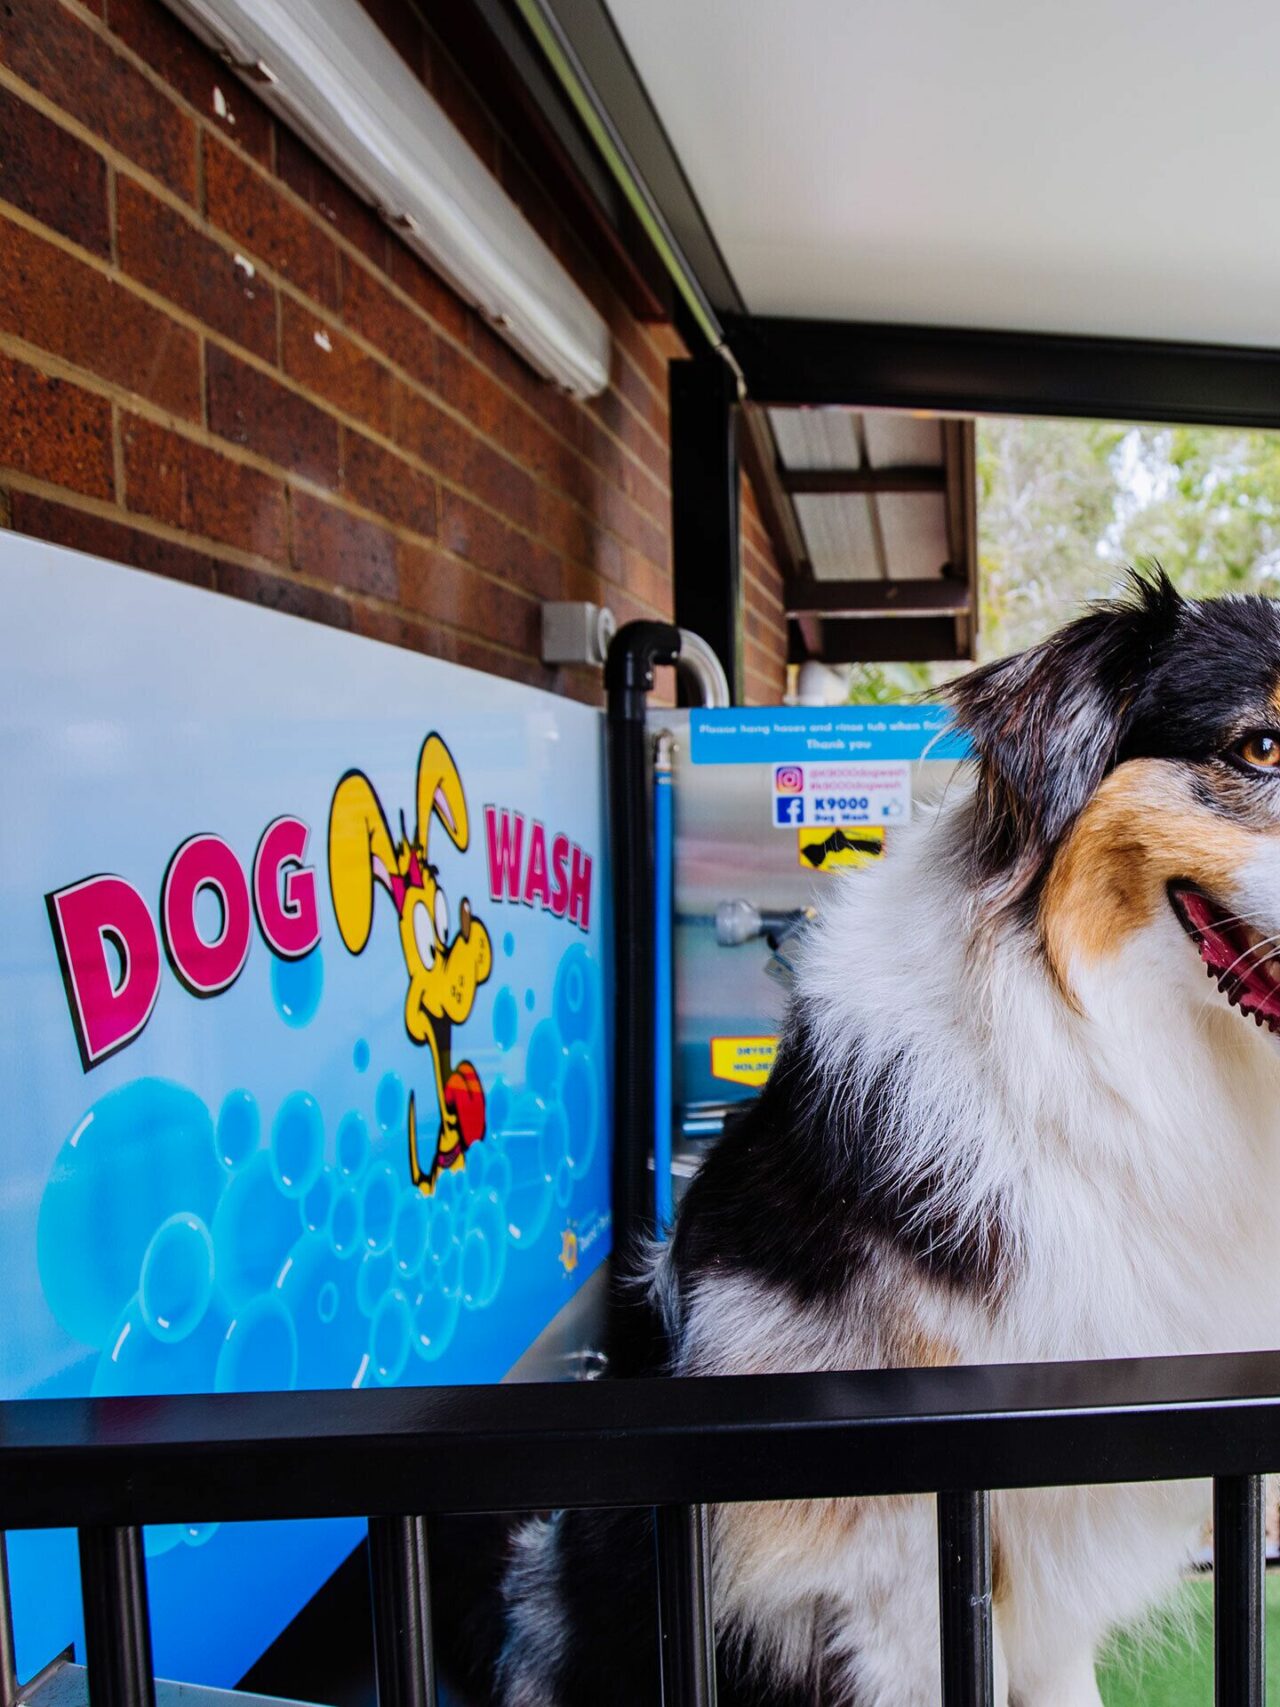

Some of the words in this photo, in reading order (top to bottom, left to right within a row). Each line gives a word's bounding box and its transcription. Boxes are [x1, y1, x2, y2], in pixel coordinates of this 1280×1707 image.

[699, 724, 737, 734] Please
[740, 724, 770, 735] hang
[773, 724, 806, 733] hoses
[809, 722, 832, 732] and
[835, 723, 864, 732] rinse
[867, 721, 887, 731] tub
[889, 721, 920, 731] when
[806, 739, 845, 749] Thank
[848, 741, 872, 751] you
[815, 797, 868, 810] K9000
[815, 814, 834, 822] Dog
[483, 803, 592, 932] WASH
[44, 815, 321, 1074] DOG
